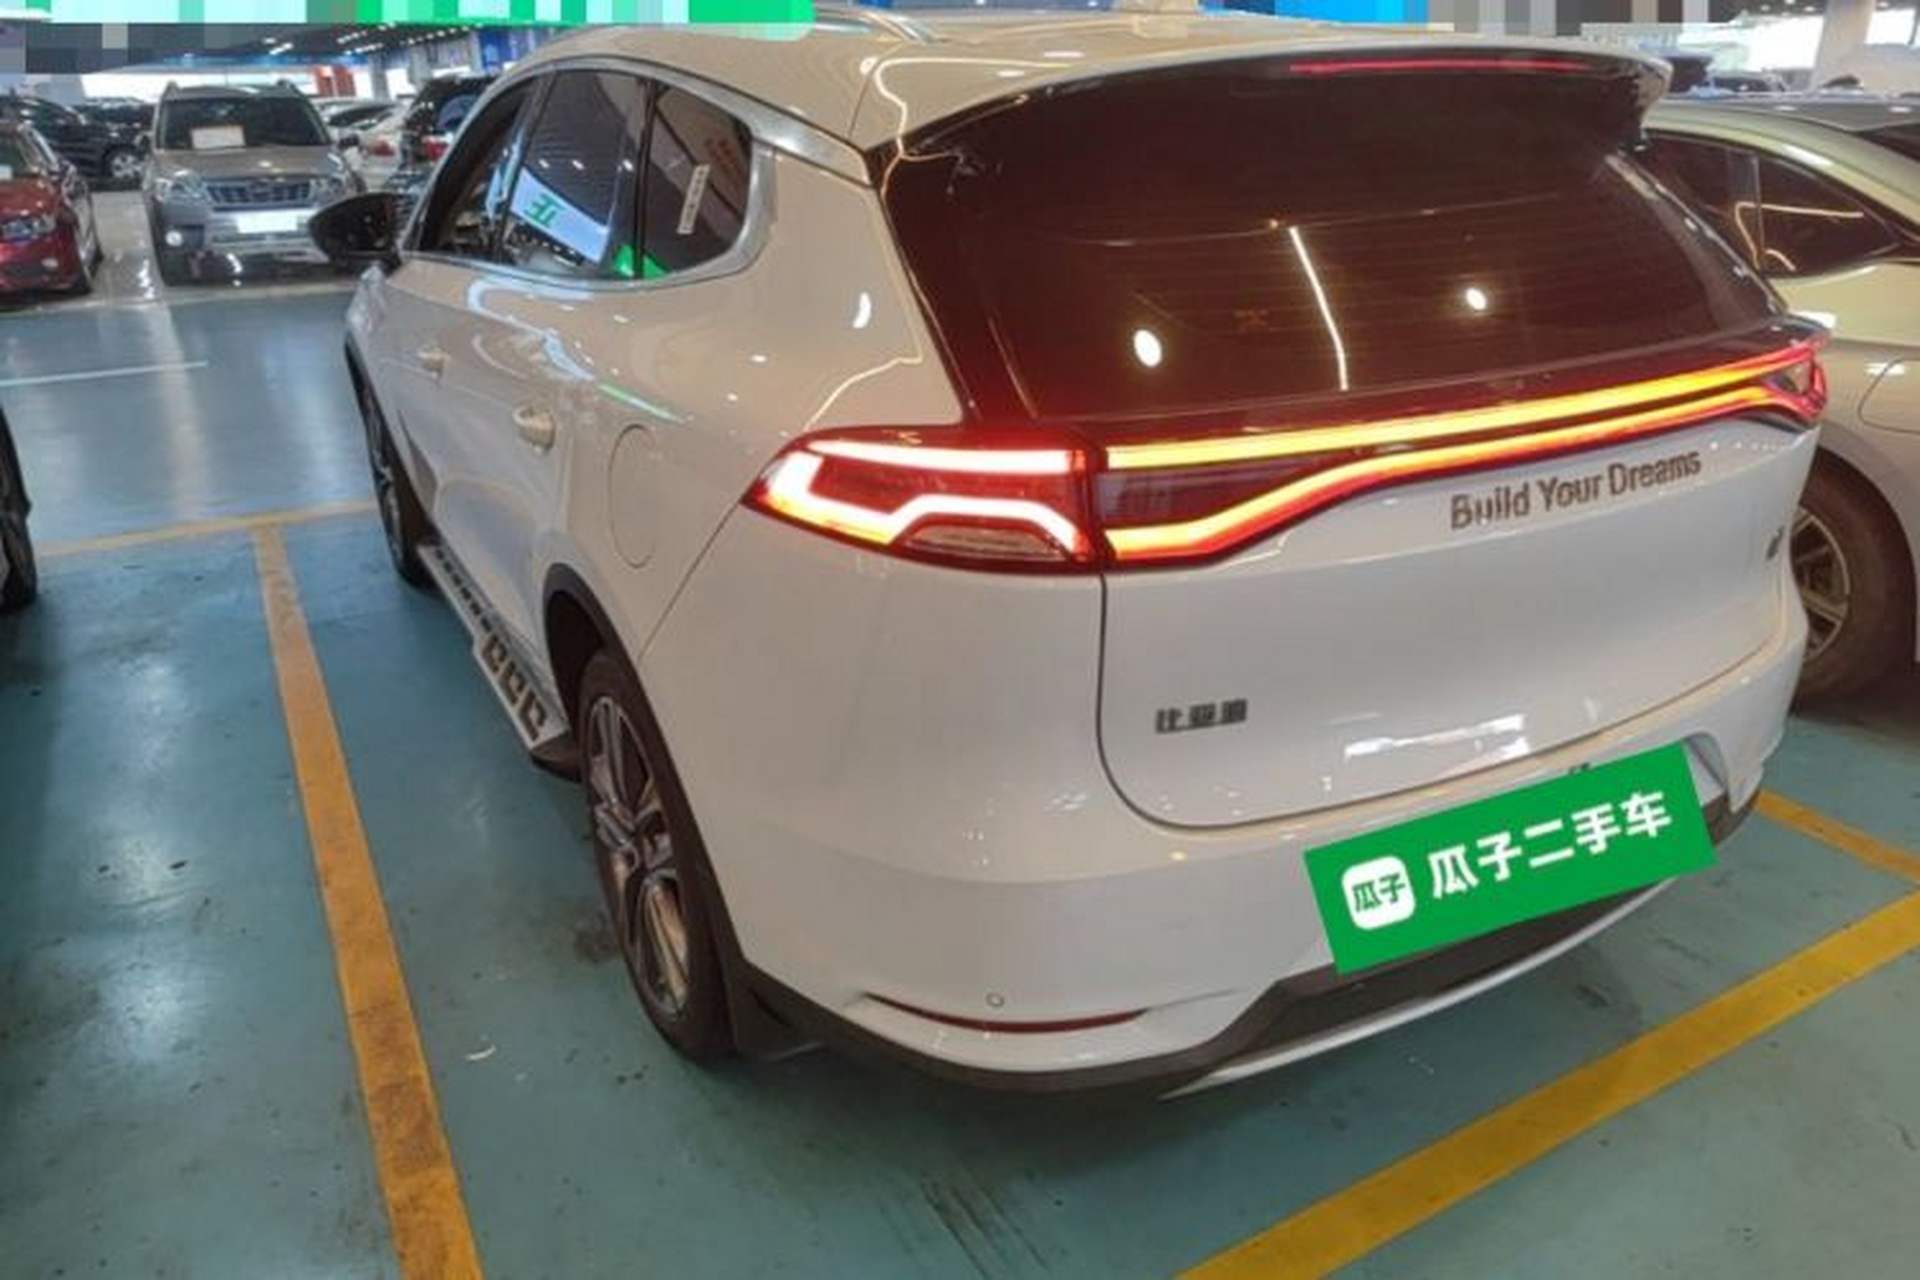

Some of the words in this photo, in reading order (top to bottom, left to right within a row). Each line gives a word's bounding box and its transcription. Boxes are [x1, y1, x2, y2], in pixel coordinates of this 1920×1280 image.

[1450, 482, 1530, 531] Build
[1537, 475, 1602, 512] Your
[1607, 451, 1703, 497] Dreams
